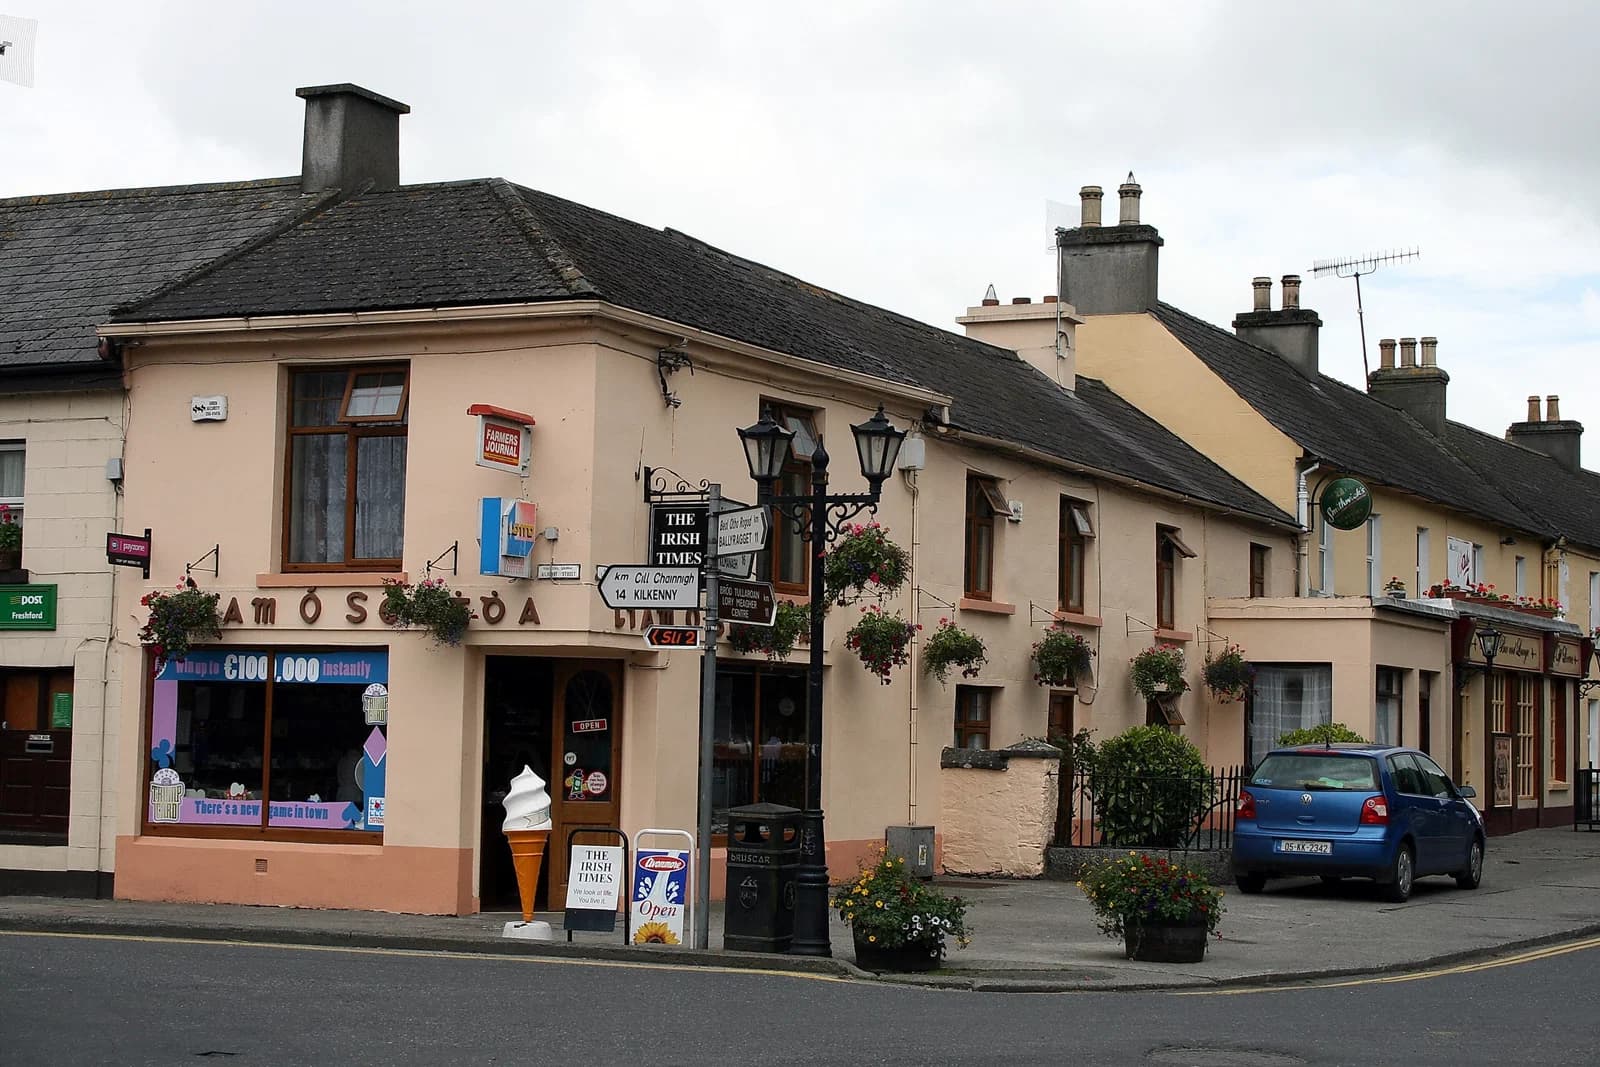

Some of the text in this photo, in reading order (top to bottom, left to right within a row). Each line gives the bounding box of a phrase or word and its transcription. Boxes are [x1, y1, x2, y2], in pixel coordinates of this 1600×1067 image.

[486, 429, 519, 446] FARMERS
[485, 441, 518, 457] JOURNAL
[666, 513, 695, 526] THE
[660, 533, 700, 546] IRISH
[719, 532, 752, 548] BALLYRAGGET
[656, 552, 702, 565] TIMES
[615, 572, 629, 581] km
[634, 572, 650, 584] Cill
[615, 589, 678, 601] 14 KILKENNY
[12, 611, 43, 620] Freshford
[731, 608, 750, 619] CENTRE
[686, 631, 696, 645] 2
[322, 660, 371, 680] instantly
[580, 721, 600, 730] OPEN
[194, 800, 329, 820] There's a new game in town
[1284, 842, 1329, 853] 05-KK-2342
[586, 850, 609, 861] THE
[580, 861, 613, 872] IRISH
[577, 872, 613, 884] TIMES
[583, 888, 596, 896] look
[578, 896, 590, 904] You
[639, 900, 677, 920] Open
